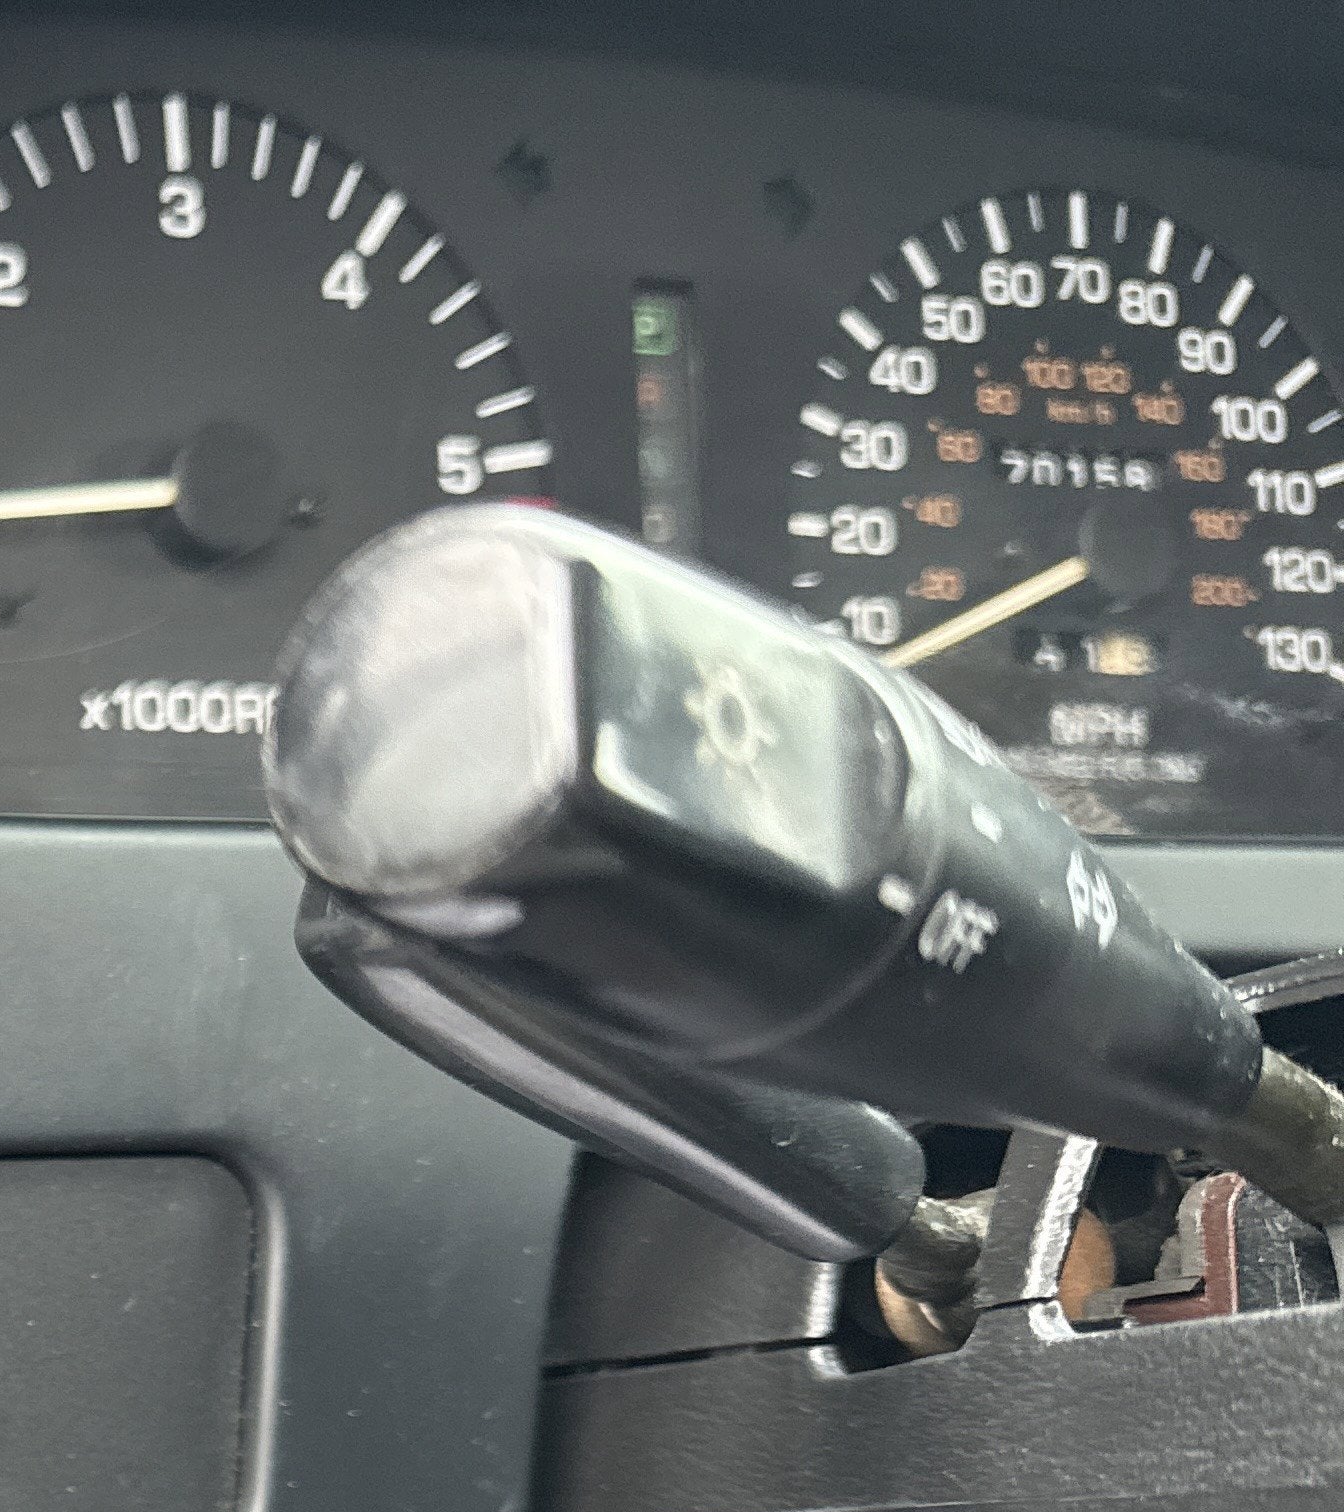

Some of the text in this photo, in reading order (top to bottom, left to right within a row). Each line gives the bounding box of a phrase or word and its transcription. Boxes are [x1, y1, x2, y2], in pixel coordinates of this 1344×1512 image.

[158, 175, 205, 239] 3
[321, 250, 369, 309] 4
[981, 259, 1045, 308] 60
[1052, 256, 1111, 303] 70
[1119, 278, 1179, 328] 80
[922, 294, 985, 343] 50
[869, 345, 938, 395] 40
[1178, 328, 1237, 375] 90
[1212, 396, 1288, 444] 100
[436, 434, 484, 494] 5
[840, 421, 908, 471] 30
[1246, 469, 1315, 516] 110
[830, 505, 898, 555] 20
[1263, 548, 1336, 592] 120
[840, 596, 900, 645] 10
[1257, 625, 1332, 672] 130
[918, 889, 1000, 974] OFF
